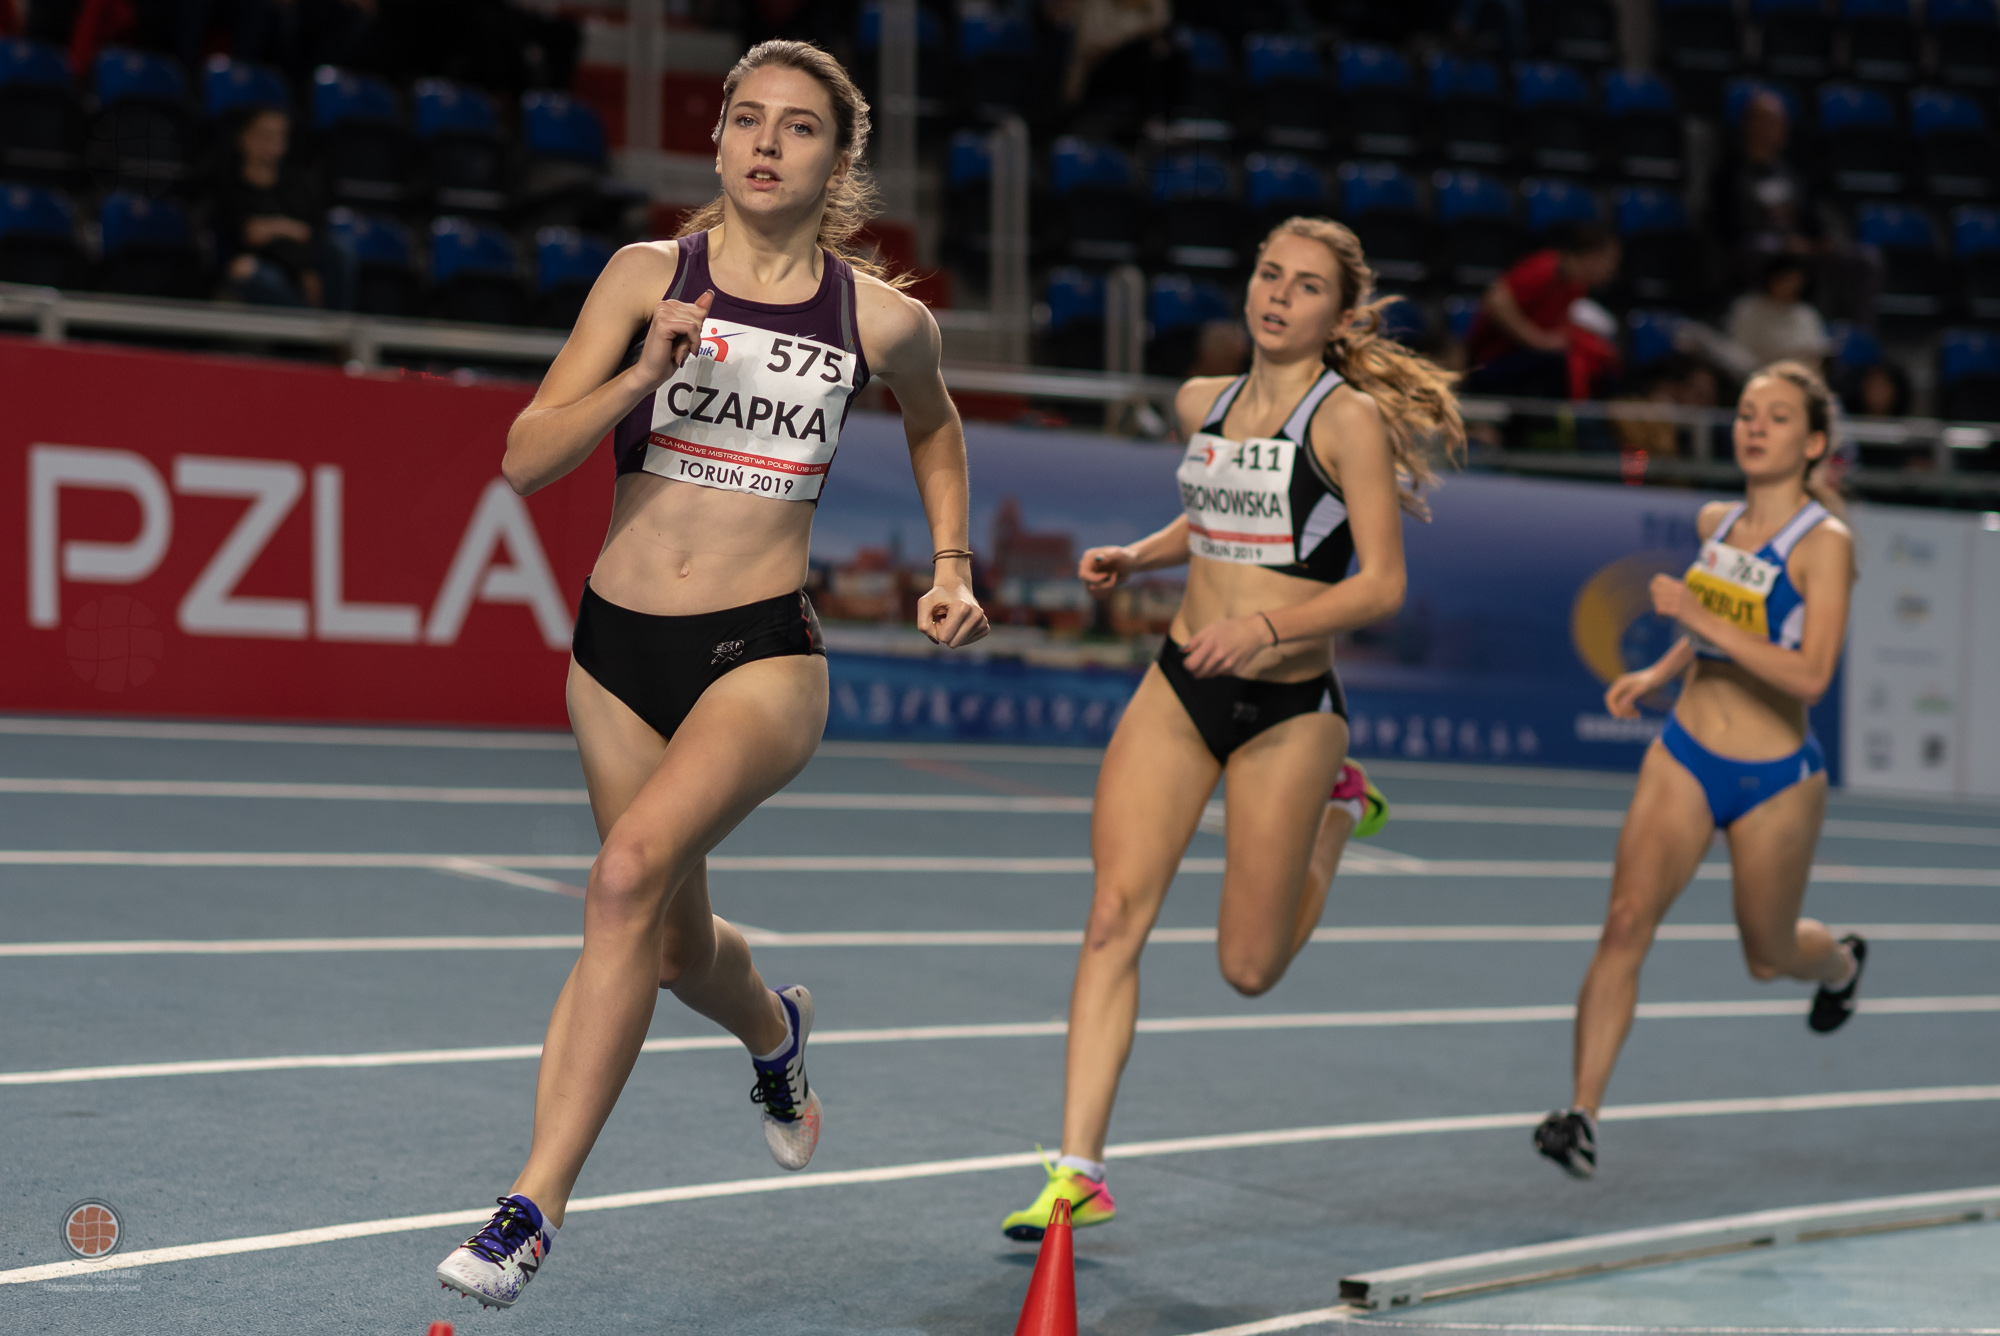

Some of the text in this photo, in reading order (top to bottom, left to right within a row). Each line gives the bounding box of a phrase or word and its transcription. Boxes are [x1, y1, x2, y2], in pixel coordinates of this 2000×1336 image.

[766, 338, 843, 383] 575
[667, 382, 827, 443] CZAPKA
[654, 436, 673, 447] PZLA
[674, 442, 706, 455] HALOWE
[708, 450, 766, 466] MISTRZOSTWA
[767, 461, 796, 471] POLSKI
[680, 459, 794, 495] TORUŃ 2019
[28, 443, 574, 651] PZLA
[1234, 546, 1263, 560] 2019
